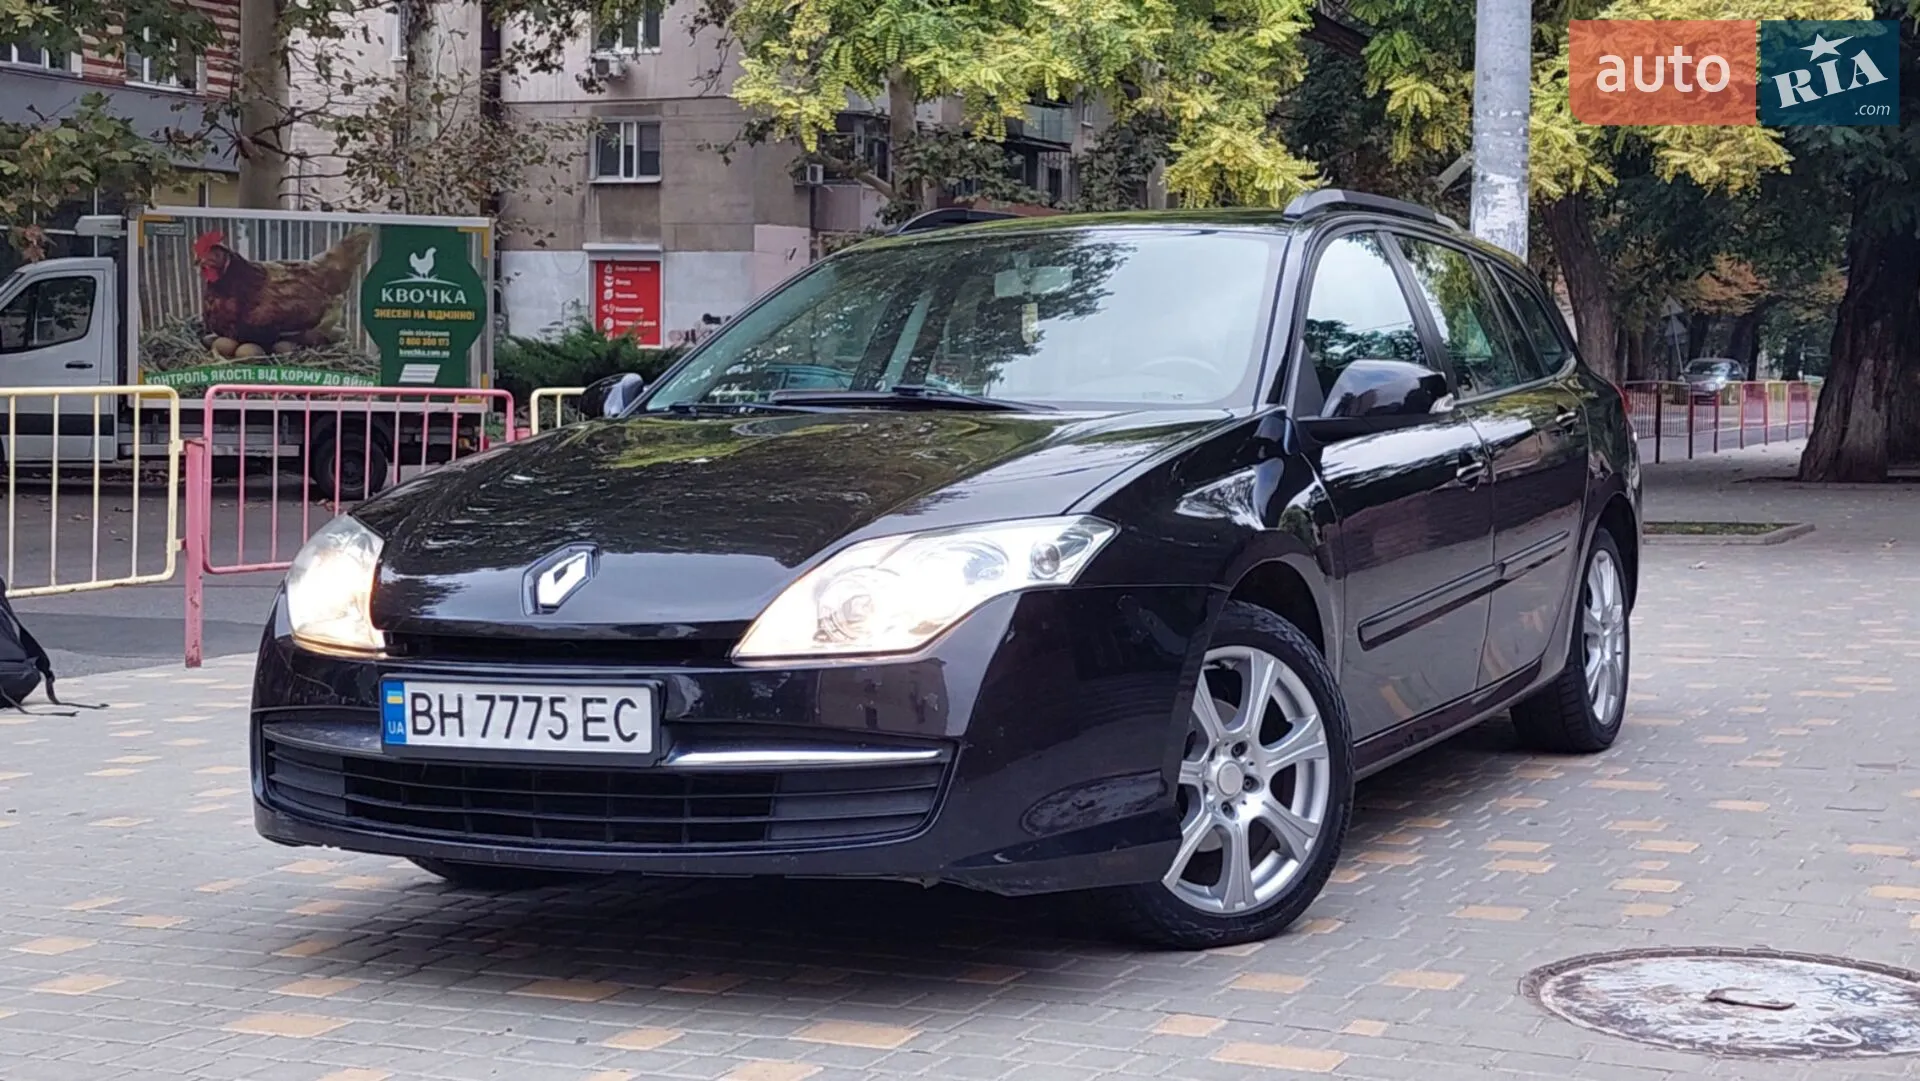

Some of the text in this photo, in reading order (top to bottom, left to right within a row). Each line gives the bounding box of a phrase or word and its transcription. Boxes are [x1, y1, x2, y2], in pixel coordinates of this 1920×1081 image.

[381, 287, 467, 305] КВОЧКА
[374, 308, 475, 320] ЗНЕСЕНІ НА ВІДМІННО!
[145, 370, 209, 386] КОНТРОЛЬ
[210, 368, 255, 381] ЯКОСТІ:
[257, 368, 278, 382] ВІД
[281, 370, 321, 383] КОРМУ
[323, 373, 340, 386] ДО
[411, 691, 638, 743] BH 7775 EC
[387, 720, 405, 735] UA
